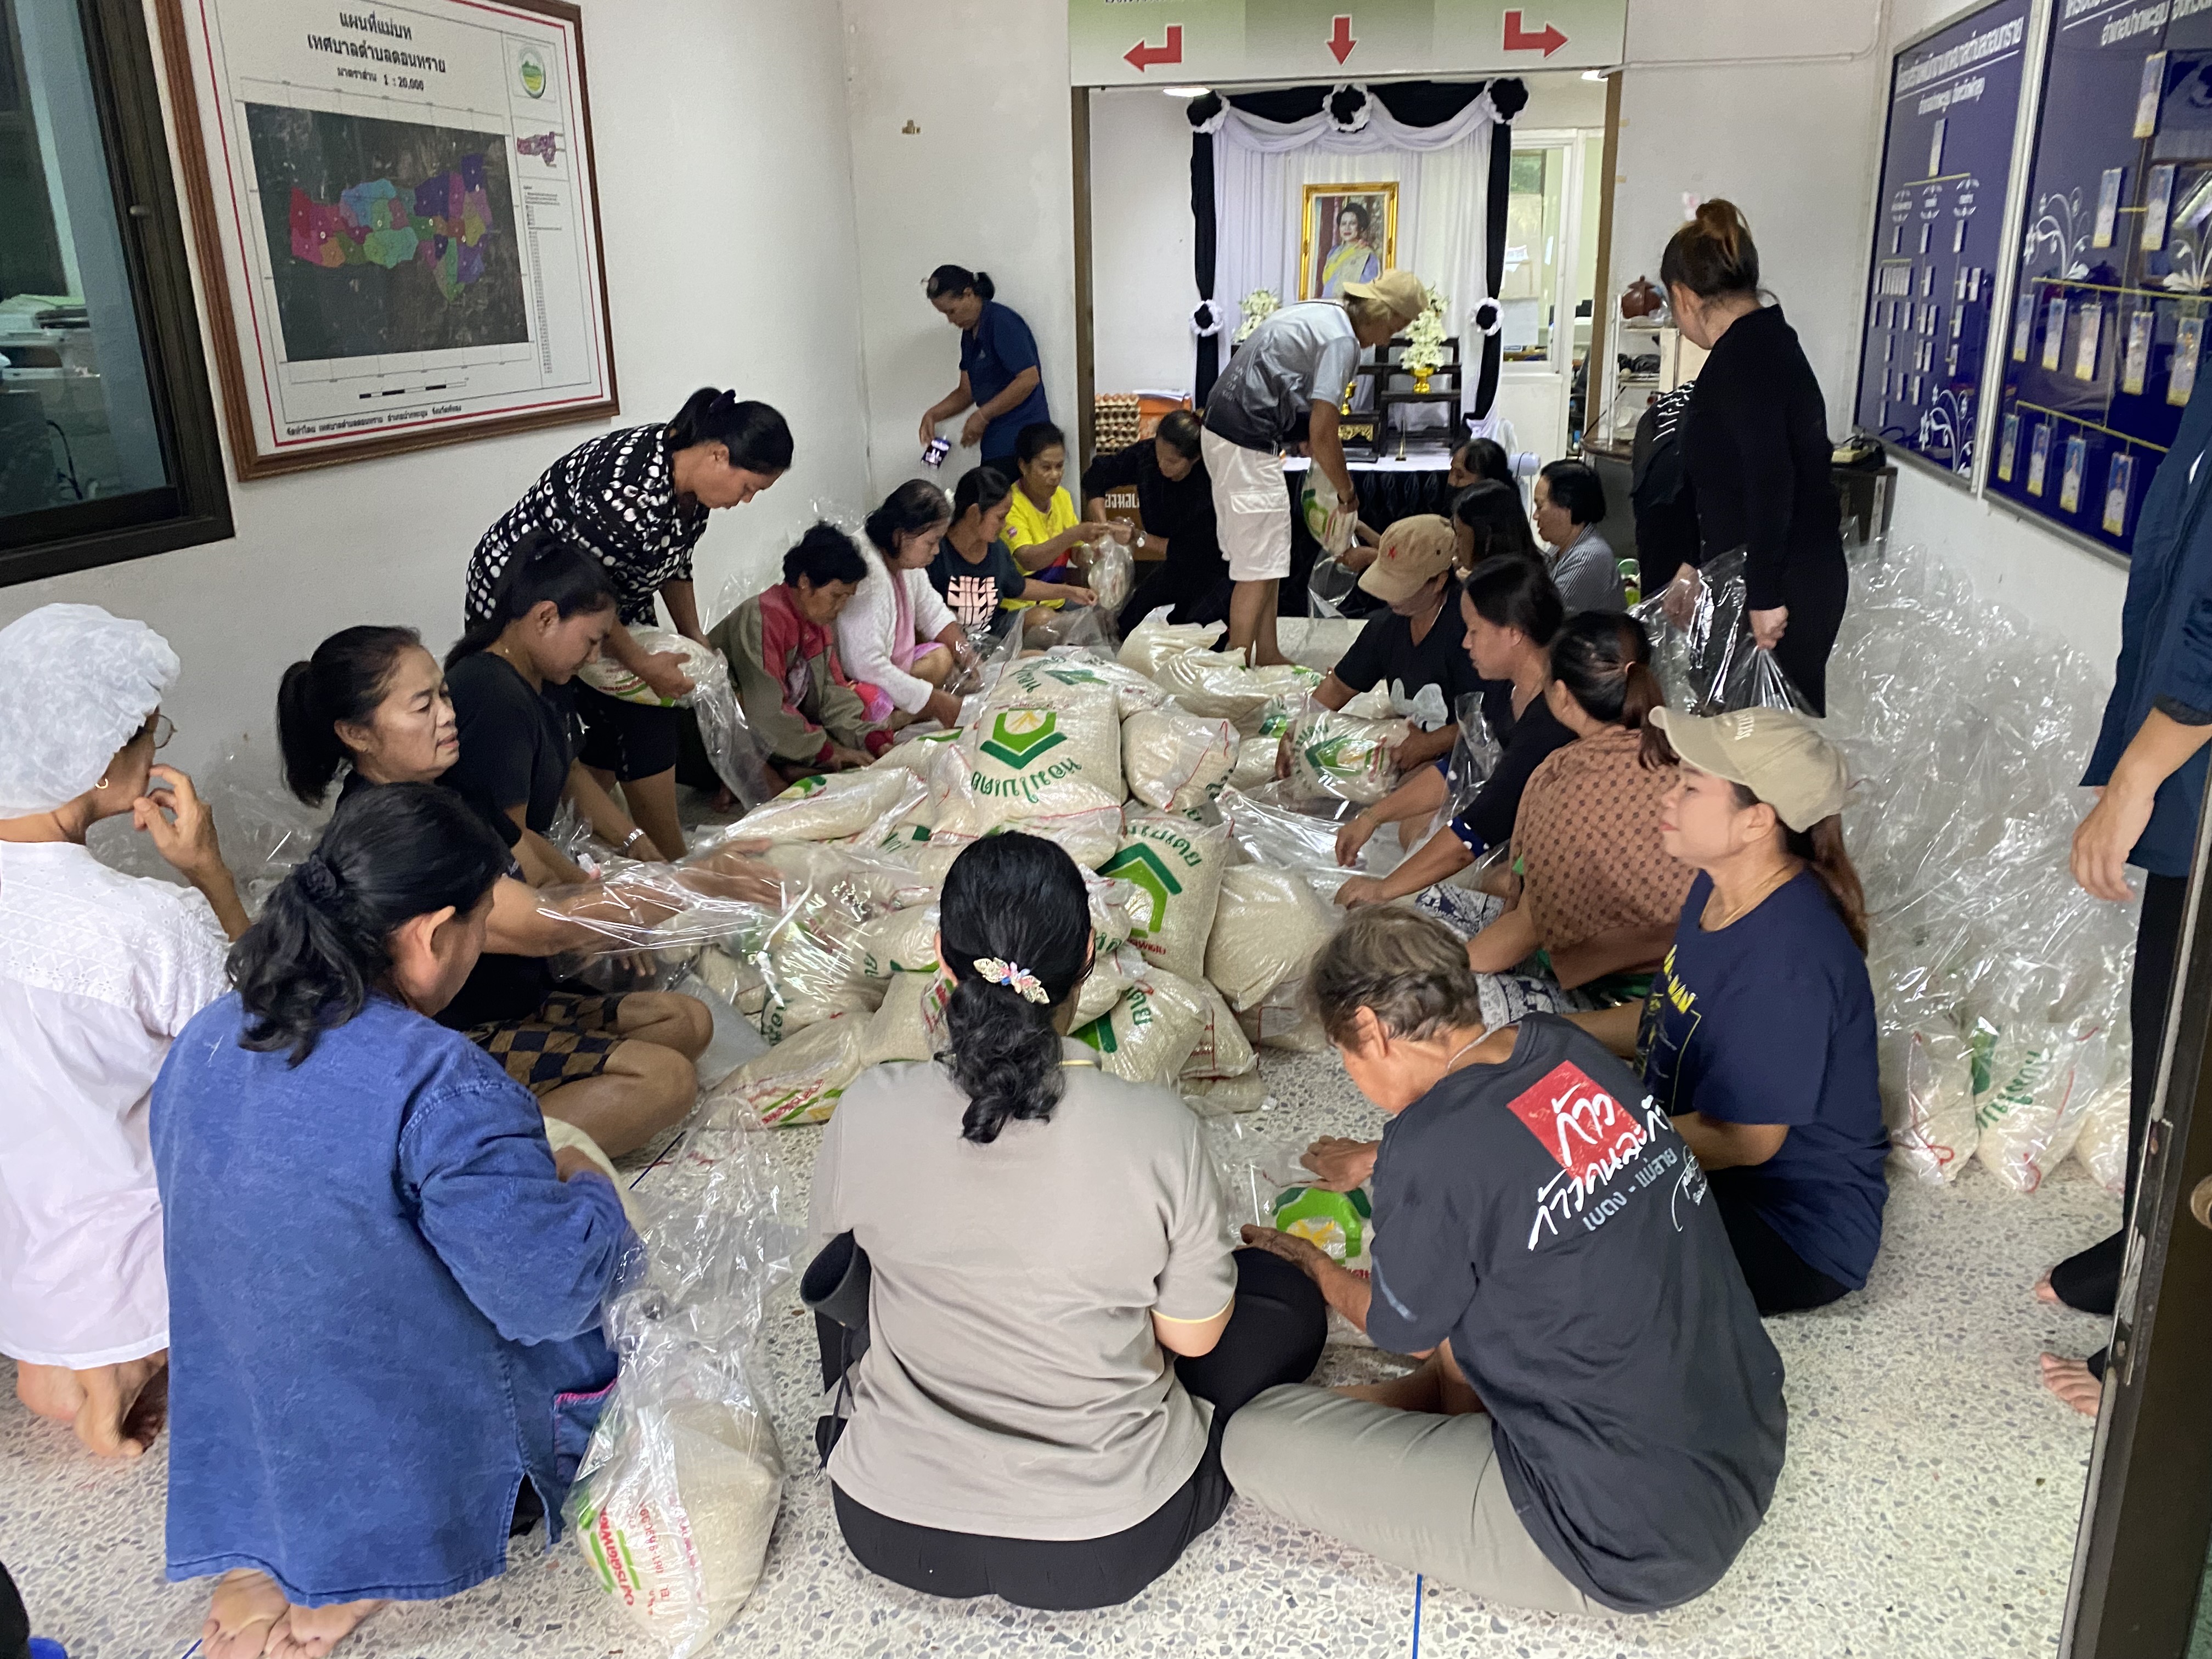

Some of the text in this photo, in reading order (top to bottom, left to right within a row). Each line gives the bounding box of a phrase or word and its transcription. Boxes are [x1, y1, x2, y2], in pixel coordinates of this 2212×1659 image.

[340, 10, 412, 41] แผนที่แม่บท
[307, 33, 445, 73] เทศบาลตำบลดอนทราย
[337, 67, 377, 82] มาตราส่วน
[384, 74, 388, 86] 1
[970, 757, 1082, 804] หอมใบเตย
[1551, 1084, 1615, 1167] ก้าว
[1582, 1191, 1628, 1232] เบตง
[1634, 1147, 1678, 1188] แม่สาย
